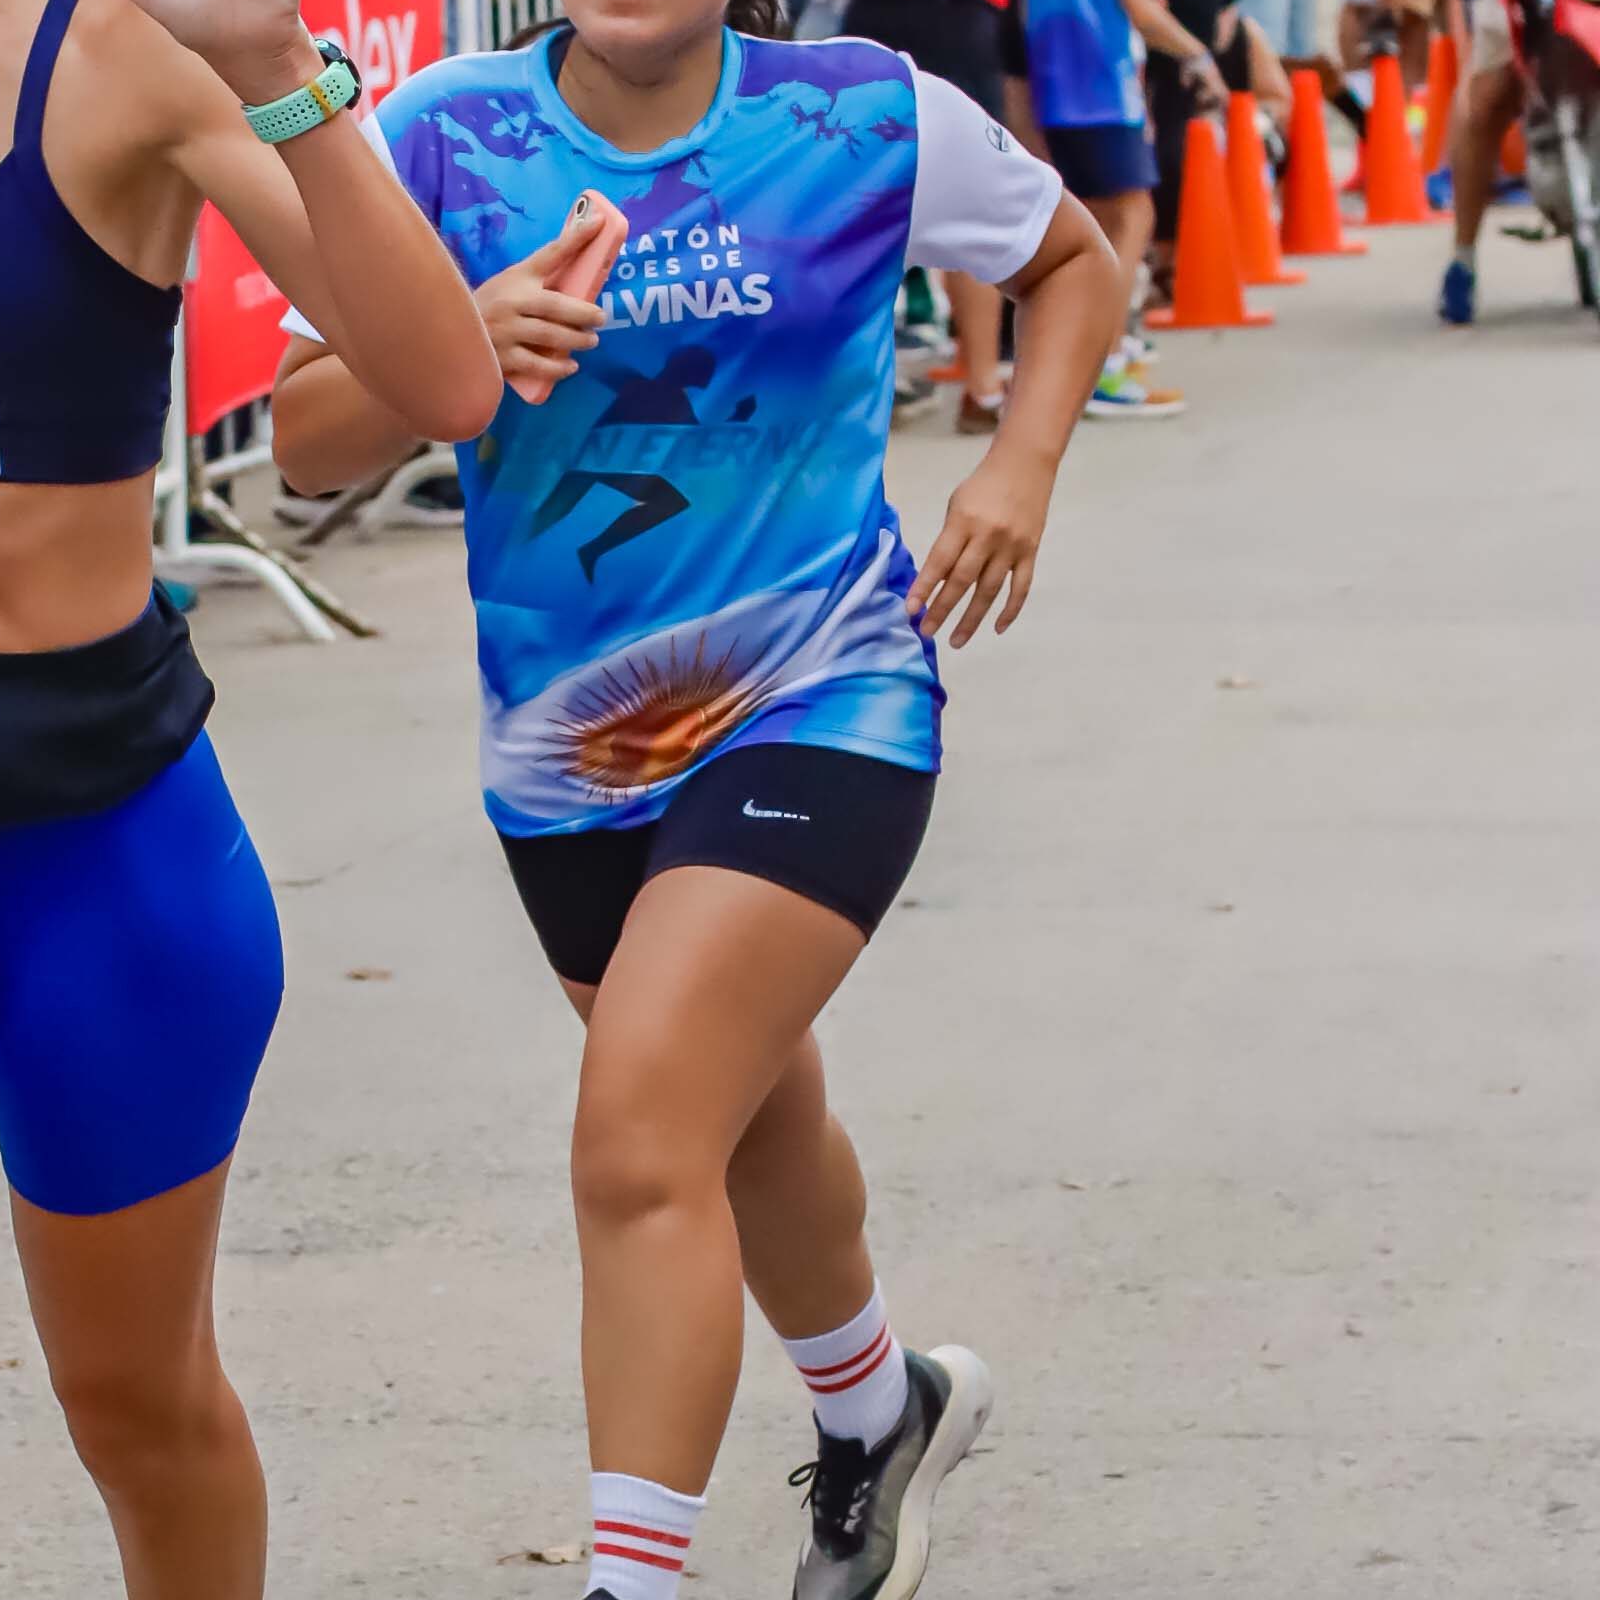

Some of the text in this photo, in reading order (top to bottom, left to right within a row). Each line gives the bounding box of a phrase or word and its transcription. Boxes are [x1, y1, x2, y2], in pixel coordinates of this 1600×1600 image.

[619, 222, 741, 256] ATÓN
[616, 249, 743, 281] OES DE
[592, 273, 773, 331] LVINAS
